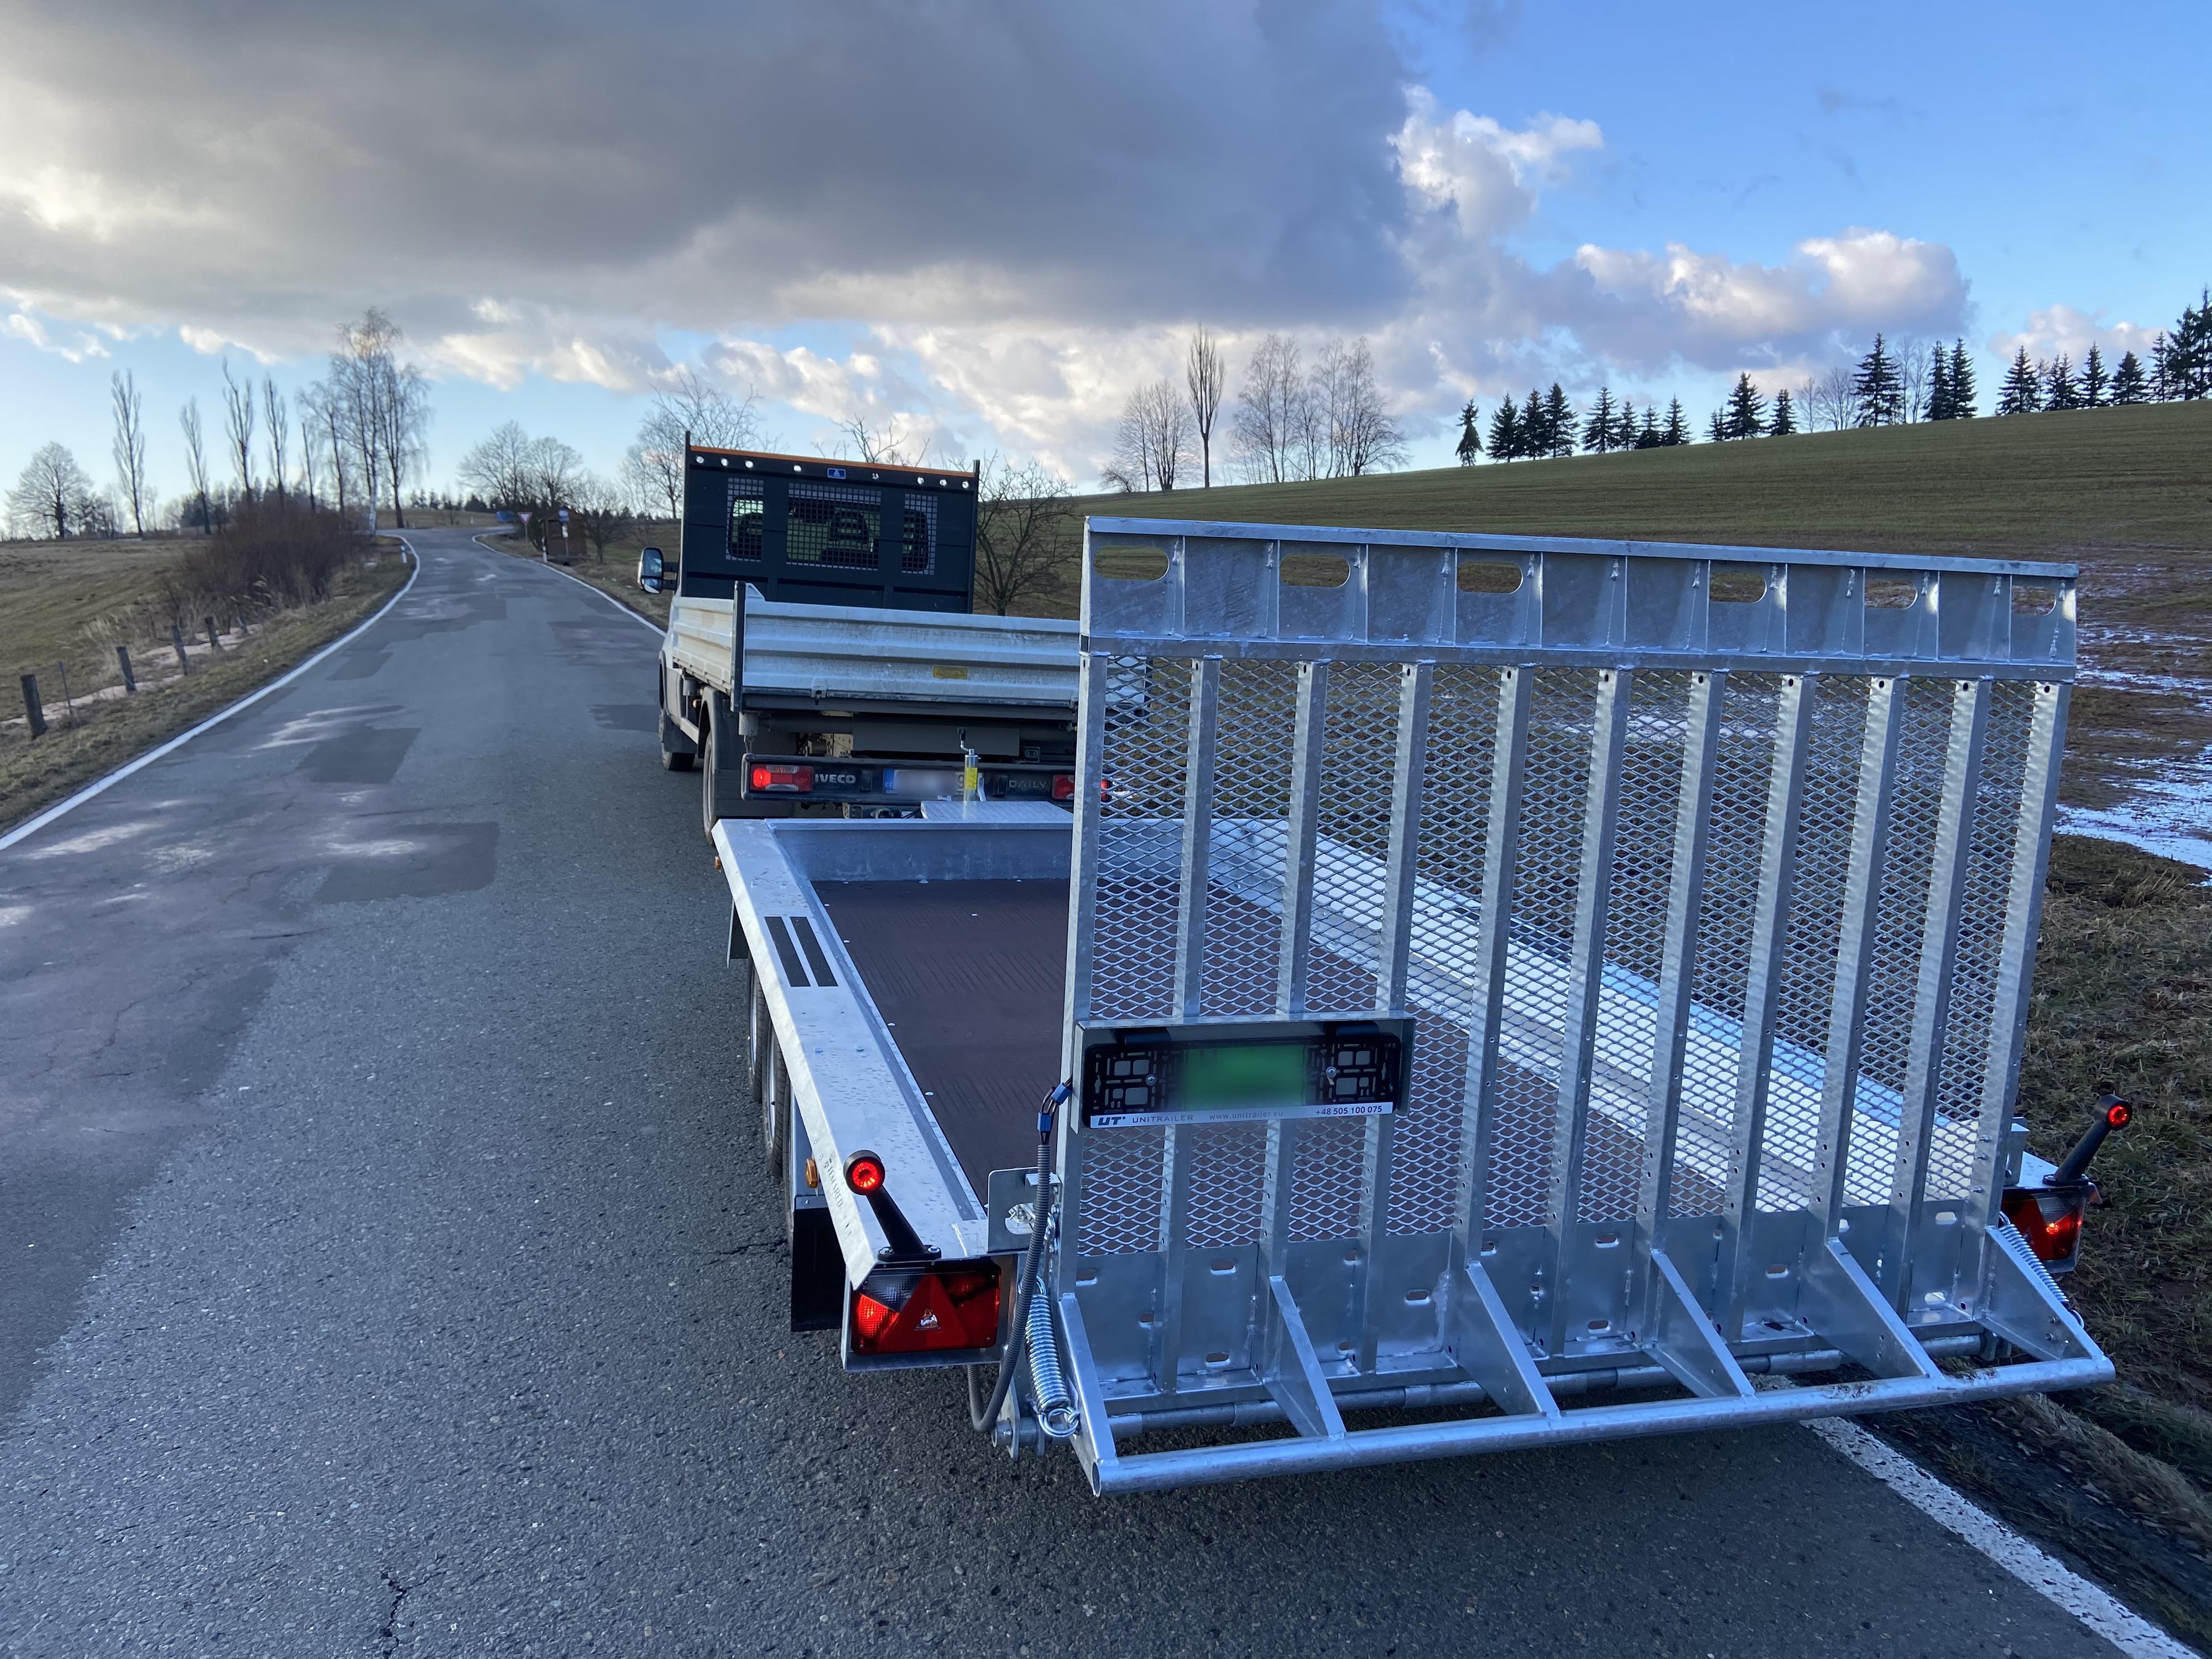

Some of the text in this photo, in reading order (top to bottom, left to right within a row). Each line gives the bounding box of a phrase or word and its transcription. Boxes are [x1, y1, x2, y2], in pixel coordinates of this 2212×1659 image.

[814, 774, 856, 784] IVECO
[1008, 780, 1047, 789] DAILY
[1350, 1106, 1366, 1114] 100
[1132, 1114, 1193, 1124] UNITRAILER
[1209, 1110, 1284, 1120] www.unitrailer.eu
[827, 1165, 844, 1208] TEMARED
